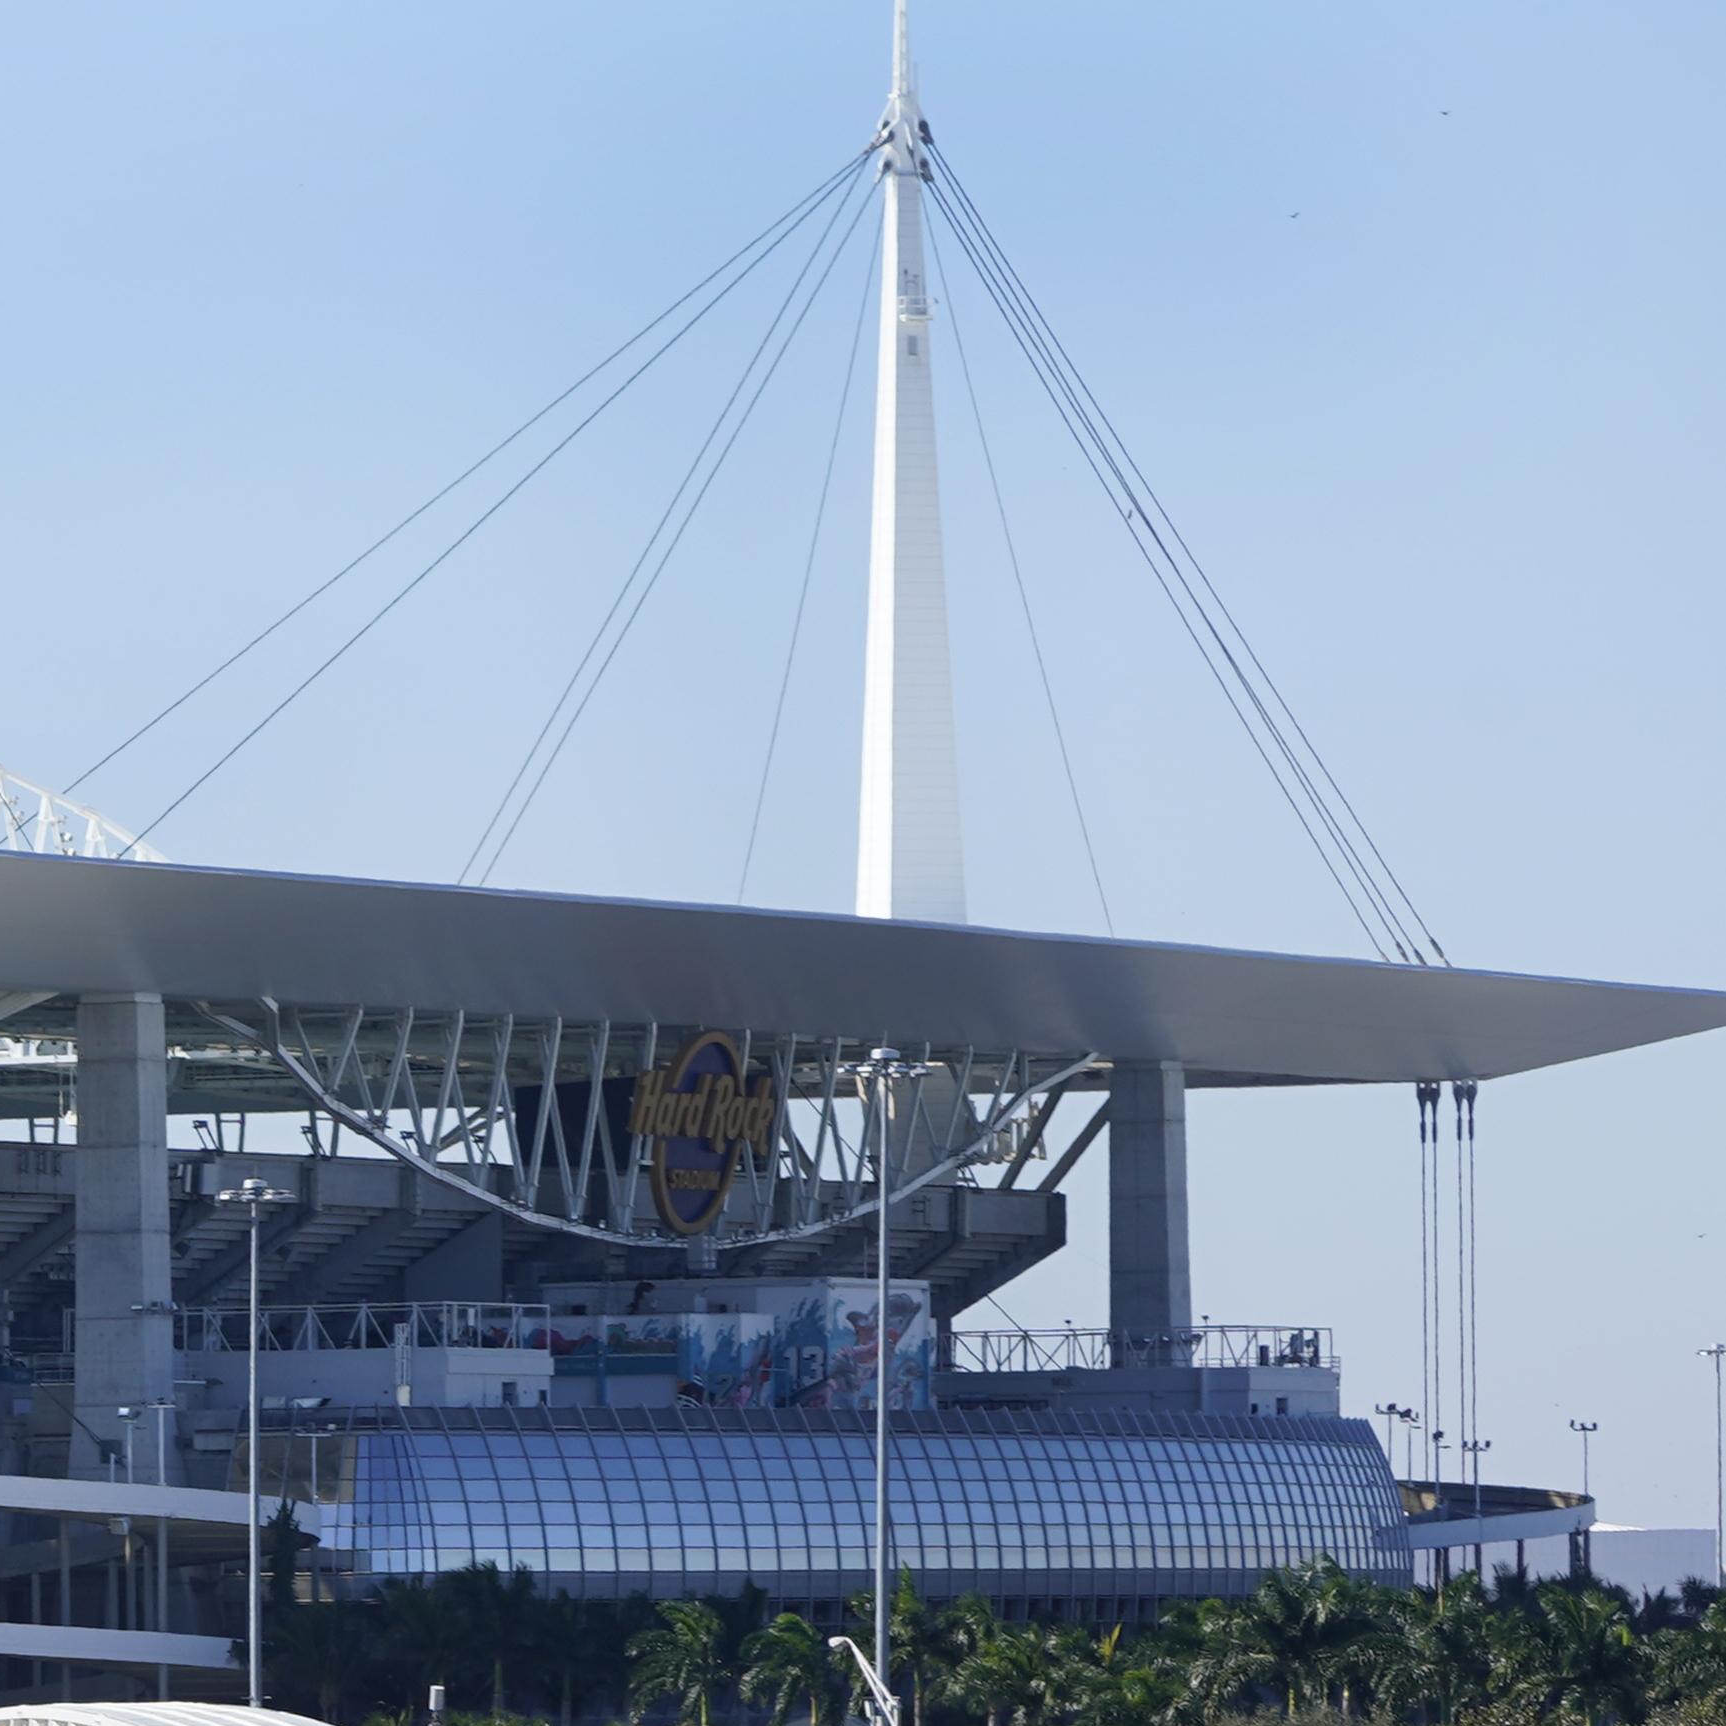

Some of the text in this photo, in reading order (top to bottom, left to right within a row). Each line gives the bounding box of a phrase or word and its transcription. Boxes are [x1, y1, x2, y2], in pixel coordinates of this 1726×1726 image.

[626, 1069, 775, 1155] Hard Rock
[669, 1169, 721, 1190] STADIUM
